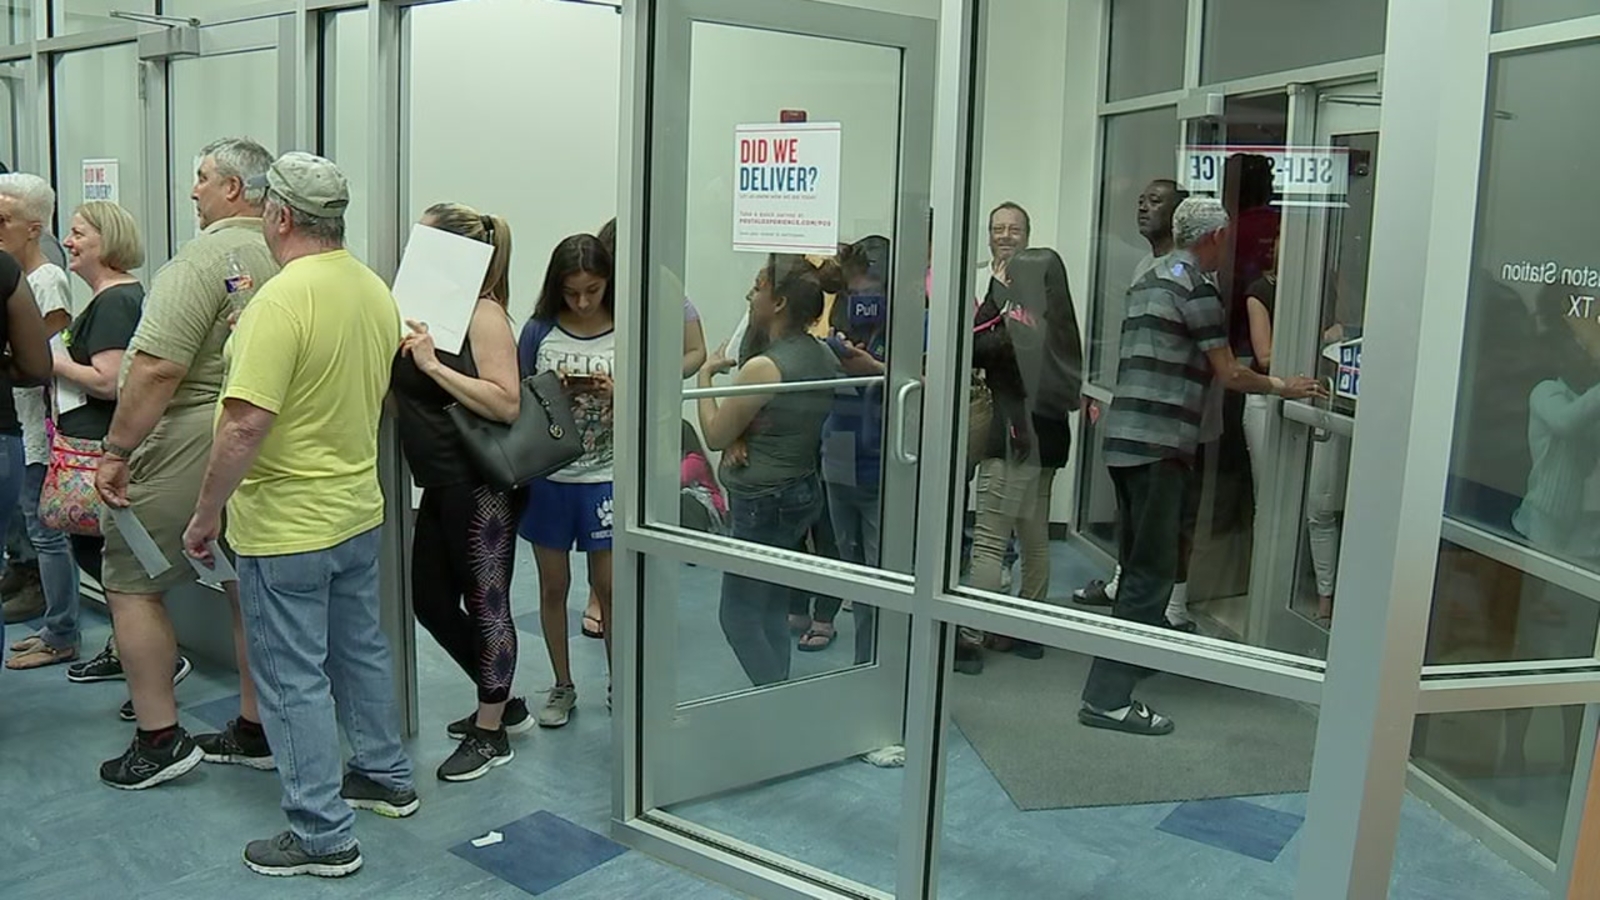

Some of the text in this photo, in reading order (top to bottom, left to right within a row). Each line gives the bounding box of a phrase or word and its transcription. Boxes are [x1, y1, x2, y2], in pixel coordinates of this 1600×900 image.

[740, 139, 798, 164] DID WE
[740, 166, 818, 192] DELIVER?
[856, 303, 878, 316] Pull
